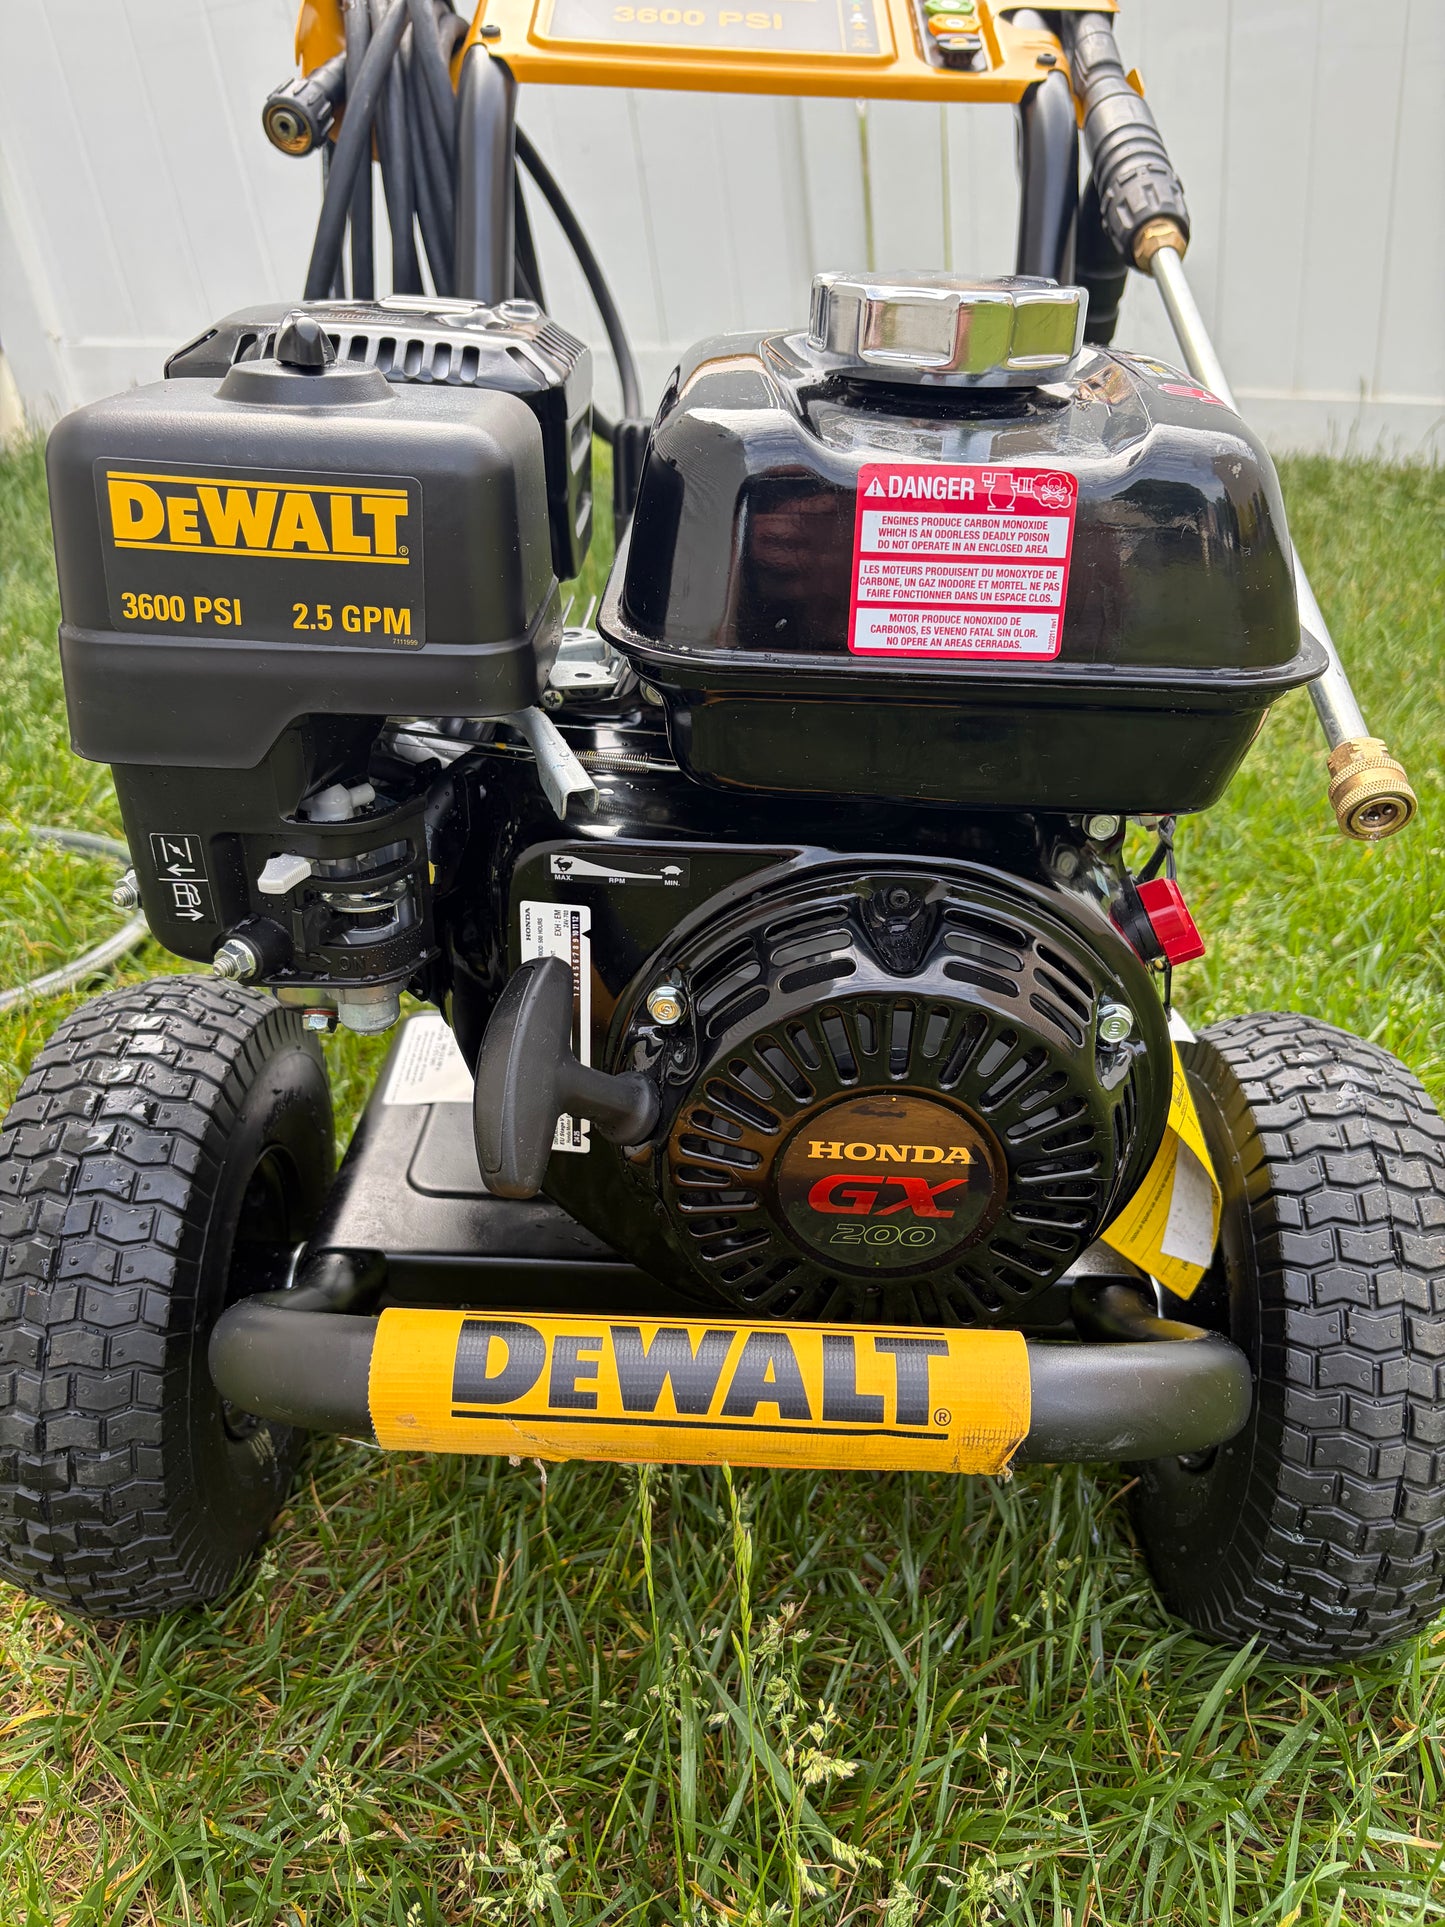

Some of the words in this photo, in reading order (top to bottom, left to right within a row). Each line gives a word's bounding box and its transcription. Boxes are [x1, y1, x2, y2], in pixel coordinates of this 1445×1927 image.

[615, 6, 705, 26] 3600
[718, 12, 782, 30] PSI
[889, 475, 975, 500] DANGER
[882, 516, 919, 526] ENGINES
[922, 517, 962, 527] PRODUCE
[964, 519, 1000, 528] CARBON
[1002, 520, 1048, 529] MONOXIDE
[878, 528, 907, 537] WHICH
[909, 529, 917, 537] IS
[920, 529, 932, 538] AN
[935, 530, 980, 540] ODORLESS
[983, 532, 1015, 541] DEADLY
[1018, 532, 1049, 542] POISON
[878, 540, 889, 549] DO
[892, 541, 910, 550] NOT
[912, 541, 949, 551] OPERATE
[952, 543, 961, 551] IN
[964, 543, 976, 551] AN
[978, 543, 1022, 553] ENCLOSED
[1025, 545, 1048, 554] AREA
[864, 565, 880, 573] LES
[882, 566, 923, 575] MOTEURS
[925, 567, 979, 577] PRODUISENT
[981, 569, 993, 577] DU
[996, 569, 1044, 579] MONOXYDE
[1046, 571, 1057, 579] DE
[860, 577, 902, 587] CARBONE,
[904, 579, 915, 587] UN
[918, 579, 935, 587] GAZ
[938, 580, 976, 589] INODORE
[978, 581, 988, 589] ET
[991, 581, 1027, 590] MORTEL.
[1030, 582, 1041, 591] NE
[1043, 583, 1059, 592] PAS
[867, 589, 890, 598] FAIRE
[893, 590, 952, 600] FONCTIONNER
[955, 592, 977, 601] DANS
[980, 592, 991, 601] UN
[994, 593, 1026, 602] ESPACE
[1029, 594, 1053, 603] CLOS.
[121, 592, 185, 622] 3600
[194, 597, 242, 626] PSI
[293, 603, 333, 630] 2.5
[342, 605, 411, 635] GPM
[889, 614, 919, 623] MOTOR
[922, 614, 961, 624] PRODUCE
[964, 615, 1007, 625] NONOXIDO
[1010, 617, 1021, 626] DE
[870, 624, 918, 635] CARBONOS,
[921, 626, 931, 635] ES
[934, 627, 967, 636] VENENO
[970, 628, 994, 636] FATAL
[997, 629, 1011, 637] SIN
[1014, 629, 1038, 638] OLOR.
[886, 637, 898, 645] NO
[901, 637, 928, 647] OPERE
[930, 639, 942, 647] AN
[944, 639, 973, 648] AREAS
[975, 640, 1022, 649] CERRADAS.
[554, 910, 561, 919] EM
[807, 1141, 978, 1164] HONDA
[808, 1174, 969, 1218] GX
[830, 1224, 936, 1247] 200
